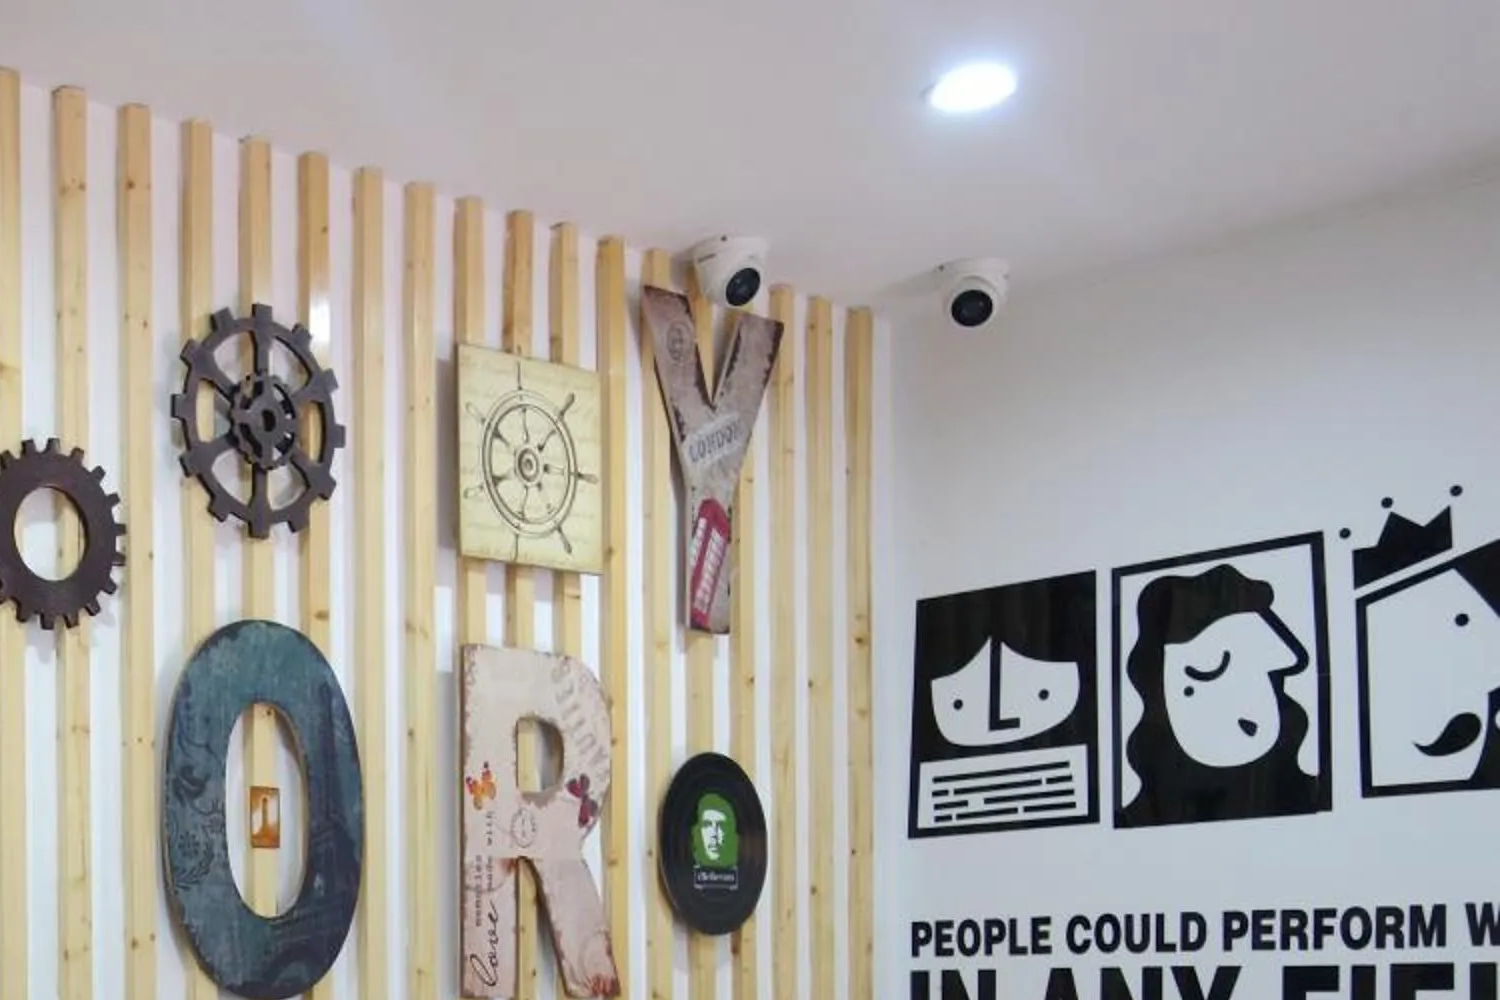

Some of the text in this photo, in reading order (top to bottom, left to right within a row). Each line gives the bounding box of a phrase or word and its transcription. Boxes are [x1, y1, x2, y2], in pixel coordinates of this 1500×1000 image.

[910, 915, 1053, 957] PEOPLE
[1066, 912, 1207, 954] COULD
[1223, 904, 1446, 952] PERFORM
